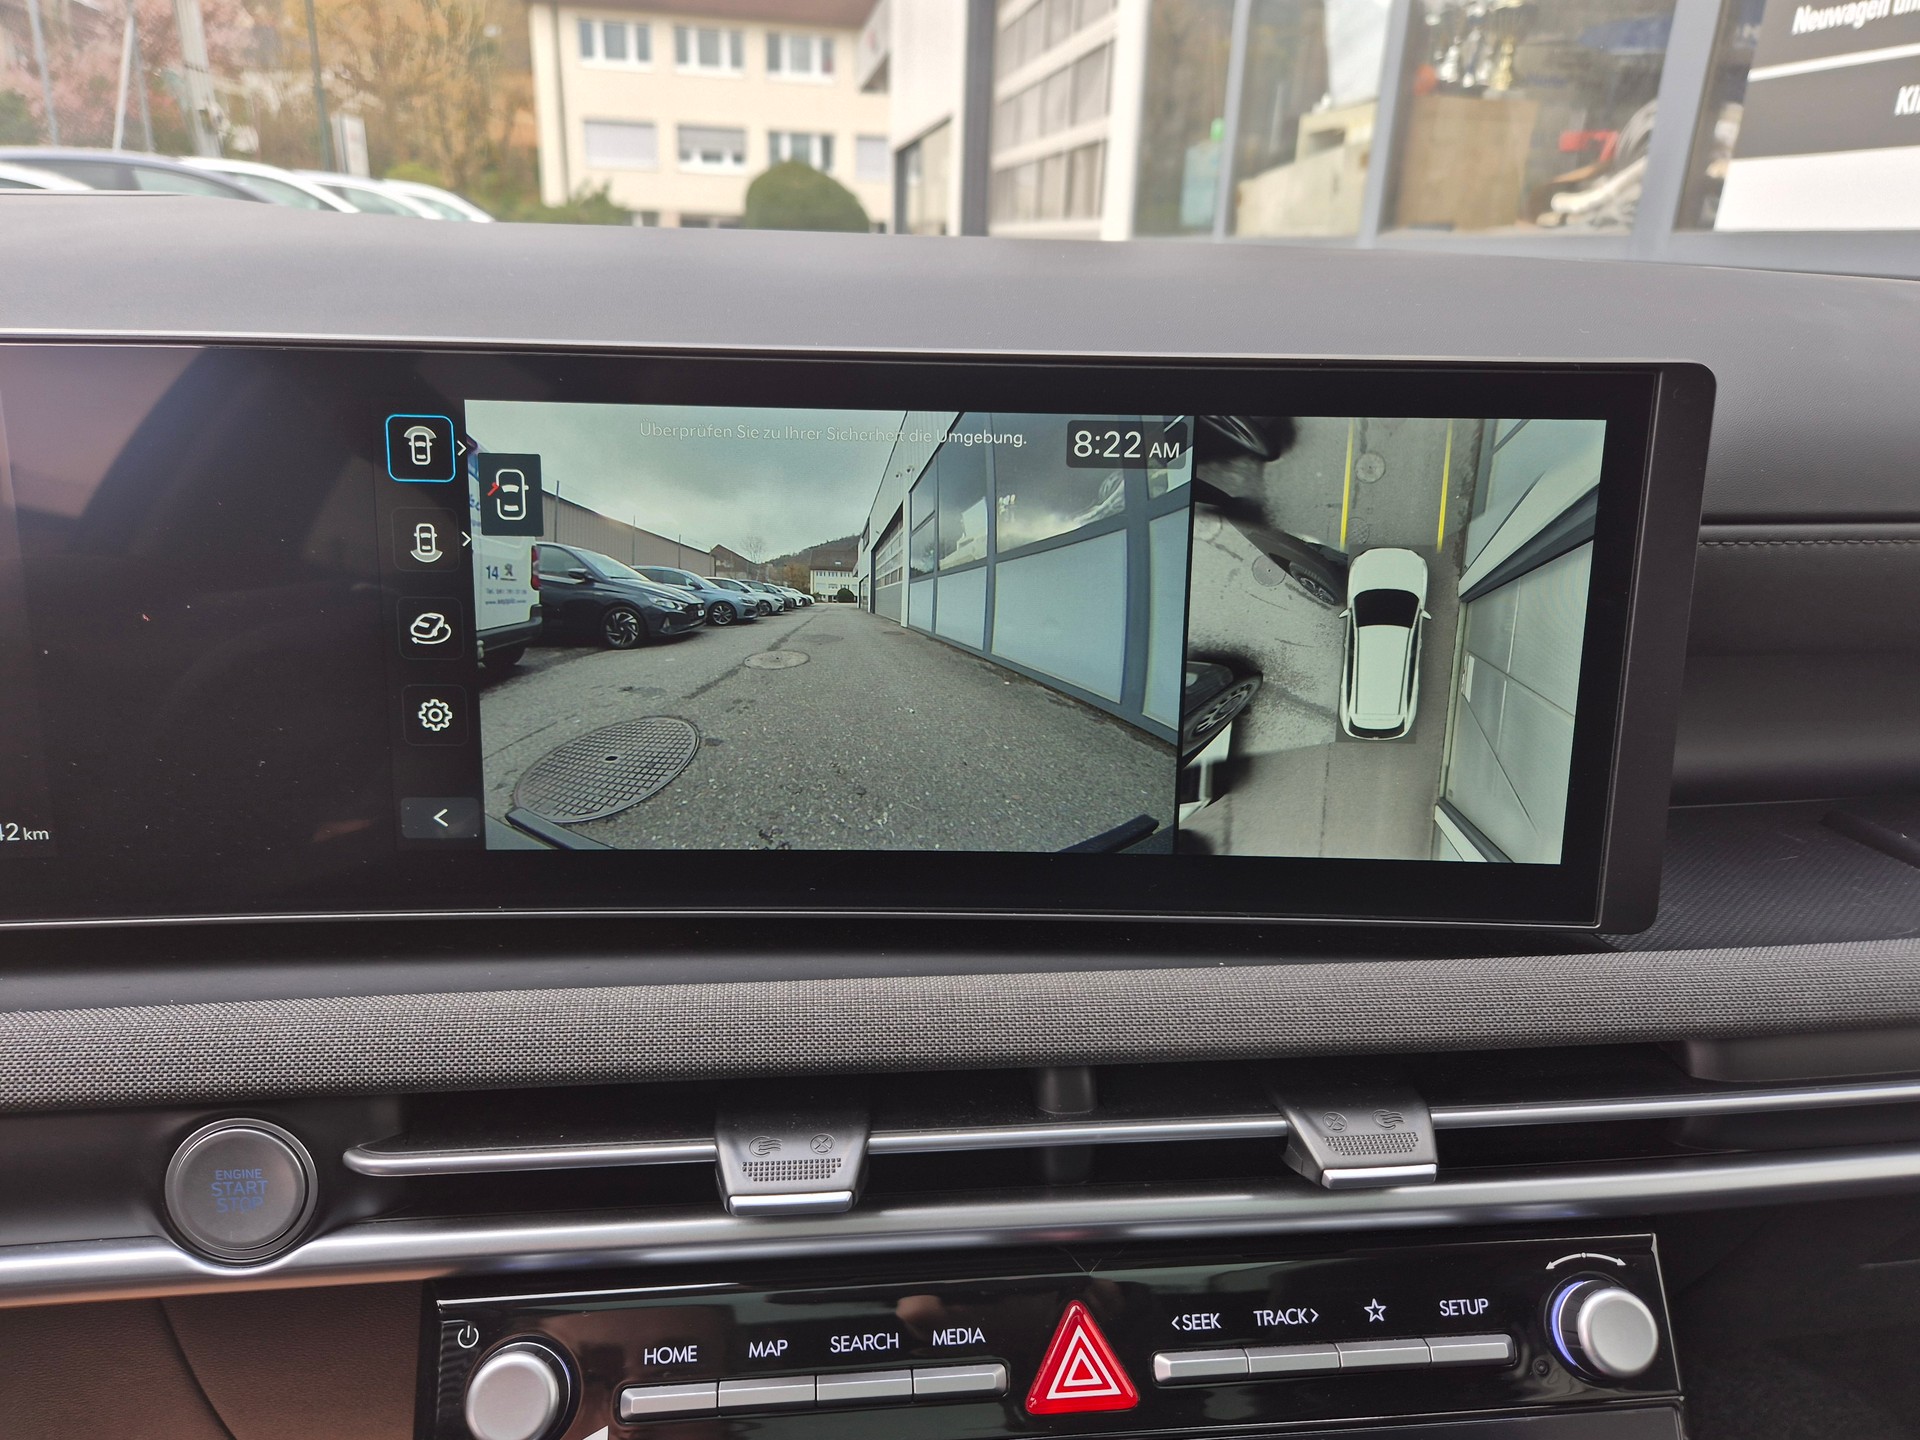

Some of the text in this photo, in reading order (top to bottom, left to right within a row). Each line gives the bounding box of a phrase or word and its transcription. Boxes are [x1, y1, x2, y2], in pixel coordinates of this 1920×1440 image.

[1791, 0, 1890, 36] Neuwagen
[639, 417, 1028, 448] Überprüfen Sie zu Ihrer Sicherheit die Umgebung.
[1073, 430, 1180, 458] 8:22 AM
[215, 1168, 262, 1181] ENGINE
[210, 1180, 268, 1197] START
[215, 1196, 264, 1213] STOP
[1439, 1298, 1489, 1317] SETUP
[644, 1327, 986, 1365] HOME MAP SEARCH MEDIA
